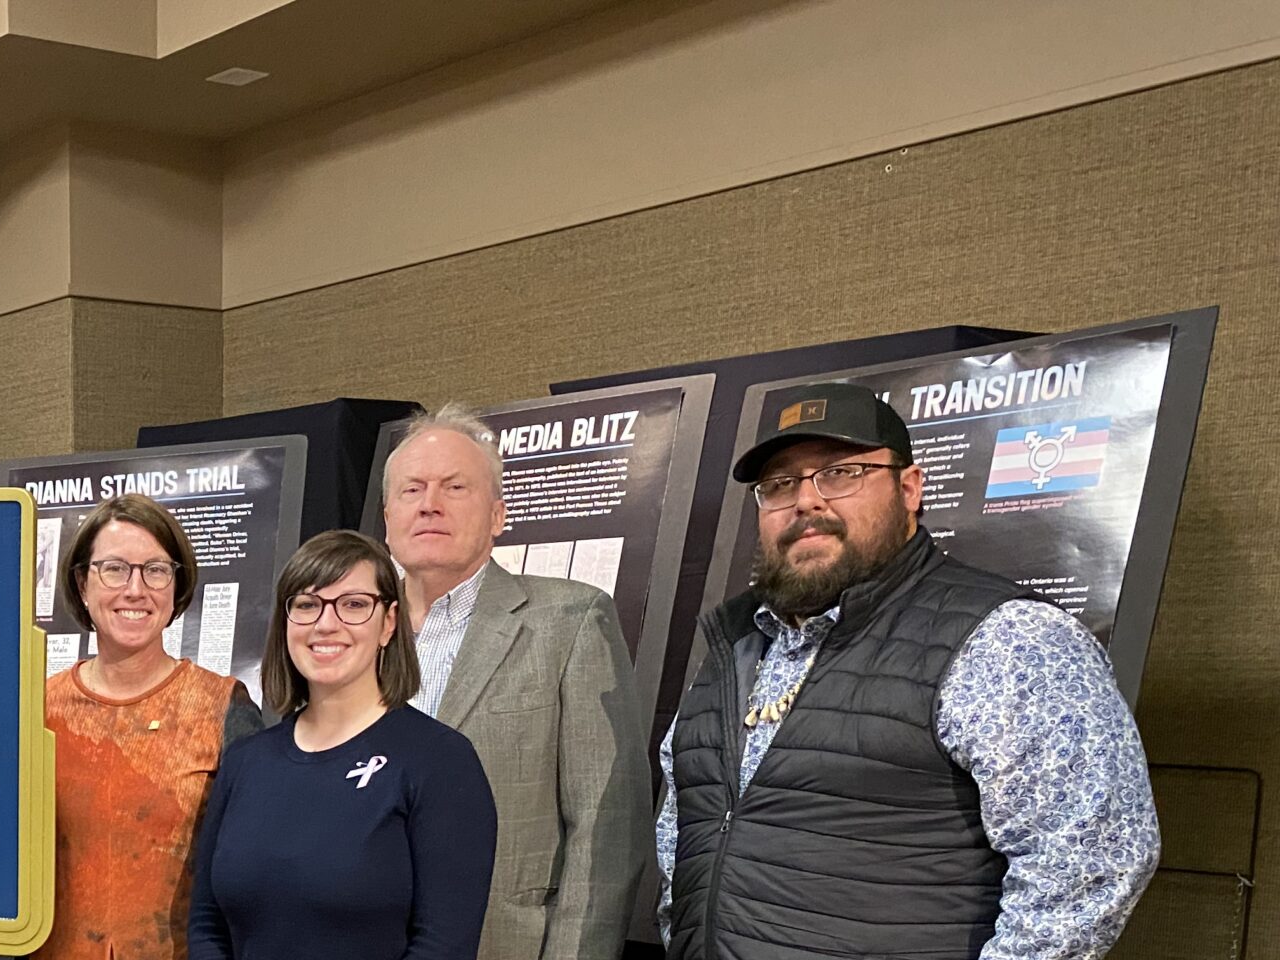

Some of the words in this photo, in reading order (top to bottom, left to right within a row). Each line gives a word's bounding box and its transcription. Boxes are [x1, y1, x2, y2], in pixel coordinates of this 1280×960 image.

[910, 361, 1086, 420] TRANSITION
[498, 421, 562, 456] MEDIA
[570, 411, 639, 447] BLITZ
[26, 478, 93, 504] DIANNA
[100, 471, 177, 498] STANDS
[187, 466, 245, 493] TRIAL
